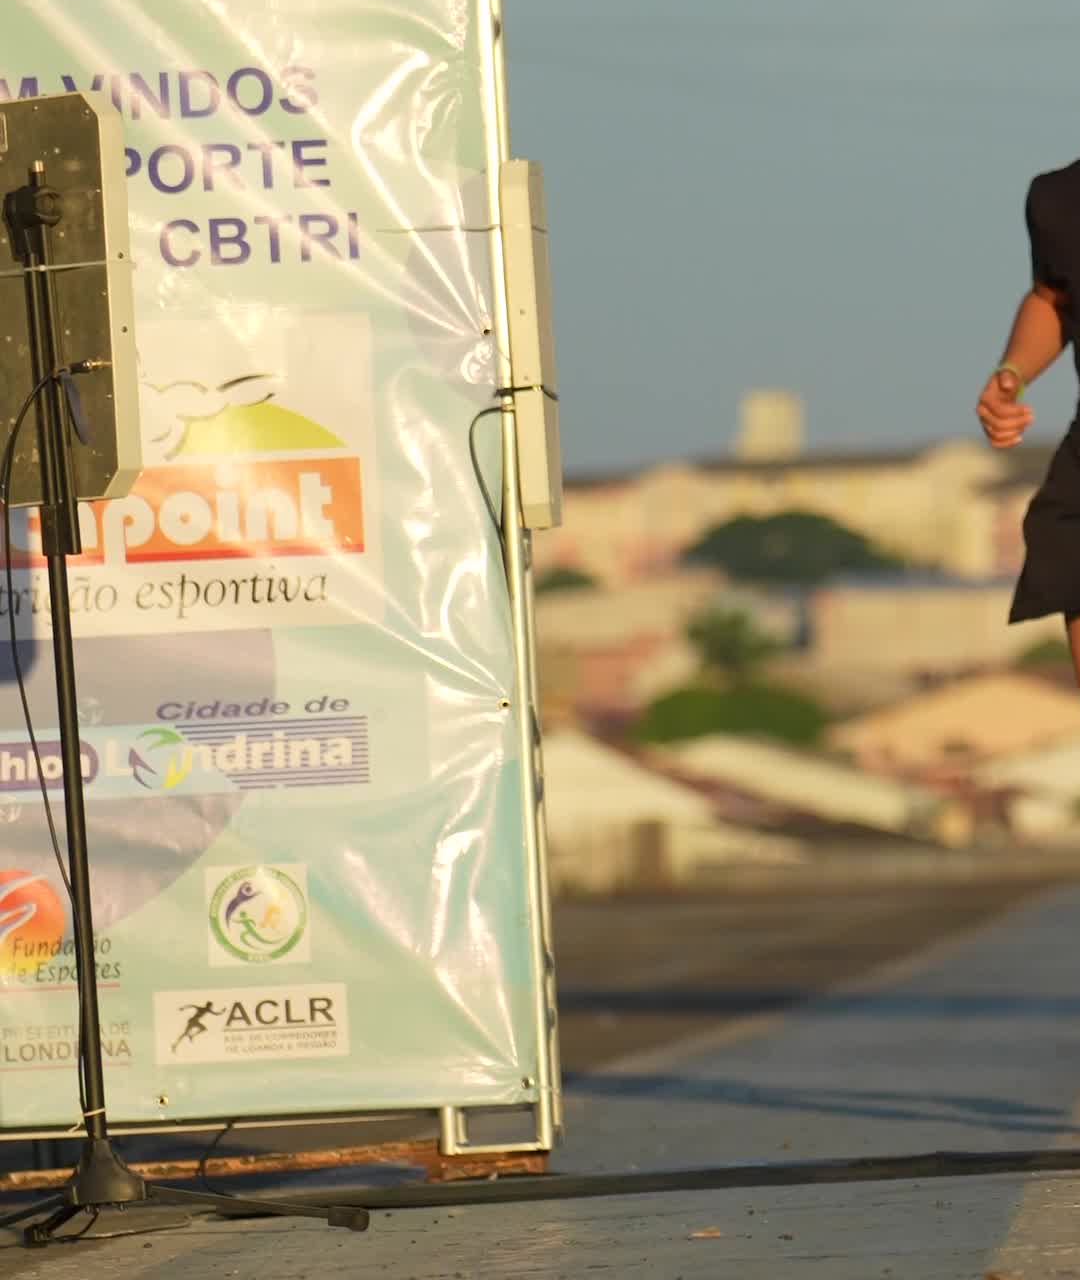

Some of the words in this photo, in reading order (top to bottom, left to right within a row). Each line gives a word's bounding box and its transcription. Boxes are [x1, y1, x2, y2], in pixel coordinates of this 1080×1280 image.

[159, 211, 361, 268] CBTRI
[135, 566, 328, 619] esportiva
[156, 697, 290, 720] Cidade
[304, 695, 350, 713] de
[12, 931, 112, 958] Fundao
[35, 961, 121, 983] Espoes
[225, 997, 335, 1027] ACLR
[4, 1038, 132, 1063] LONDNA
